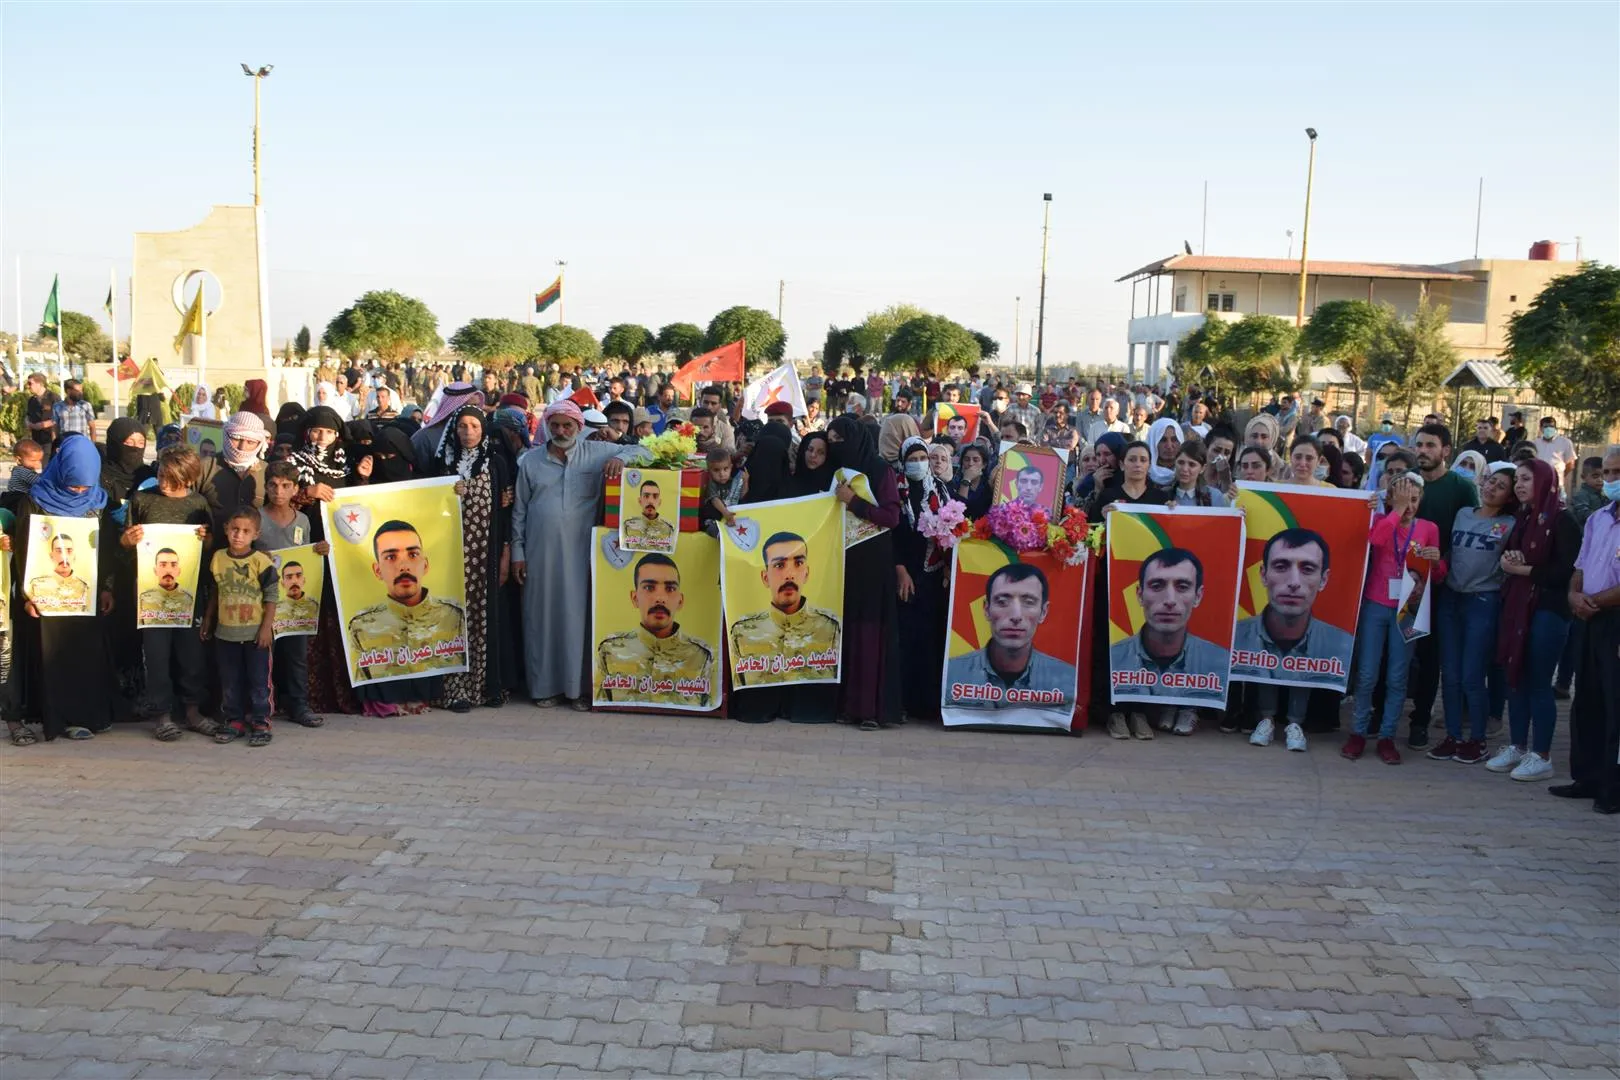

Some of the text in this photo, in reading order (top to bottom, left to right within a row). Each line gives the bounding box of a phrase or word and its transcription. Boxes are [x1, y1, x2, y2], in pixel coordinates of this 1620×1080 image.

[359, 636, 465, 667] لشهيد عمران الحامد
[735, 647, 838, 674] لشهيد عمران الحامد
[1231, 649, 1345, 676] ŞEHÎD QENDÎL
[602, 674, 711, 696] الشهيد عمران الحامد
[951, 682, 1003, 700] ŞEHÎD
[1111, 667, 1223, 692] ŞEHÎD QENDÎL
